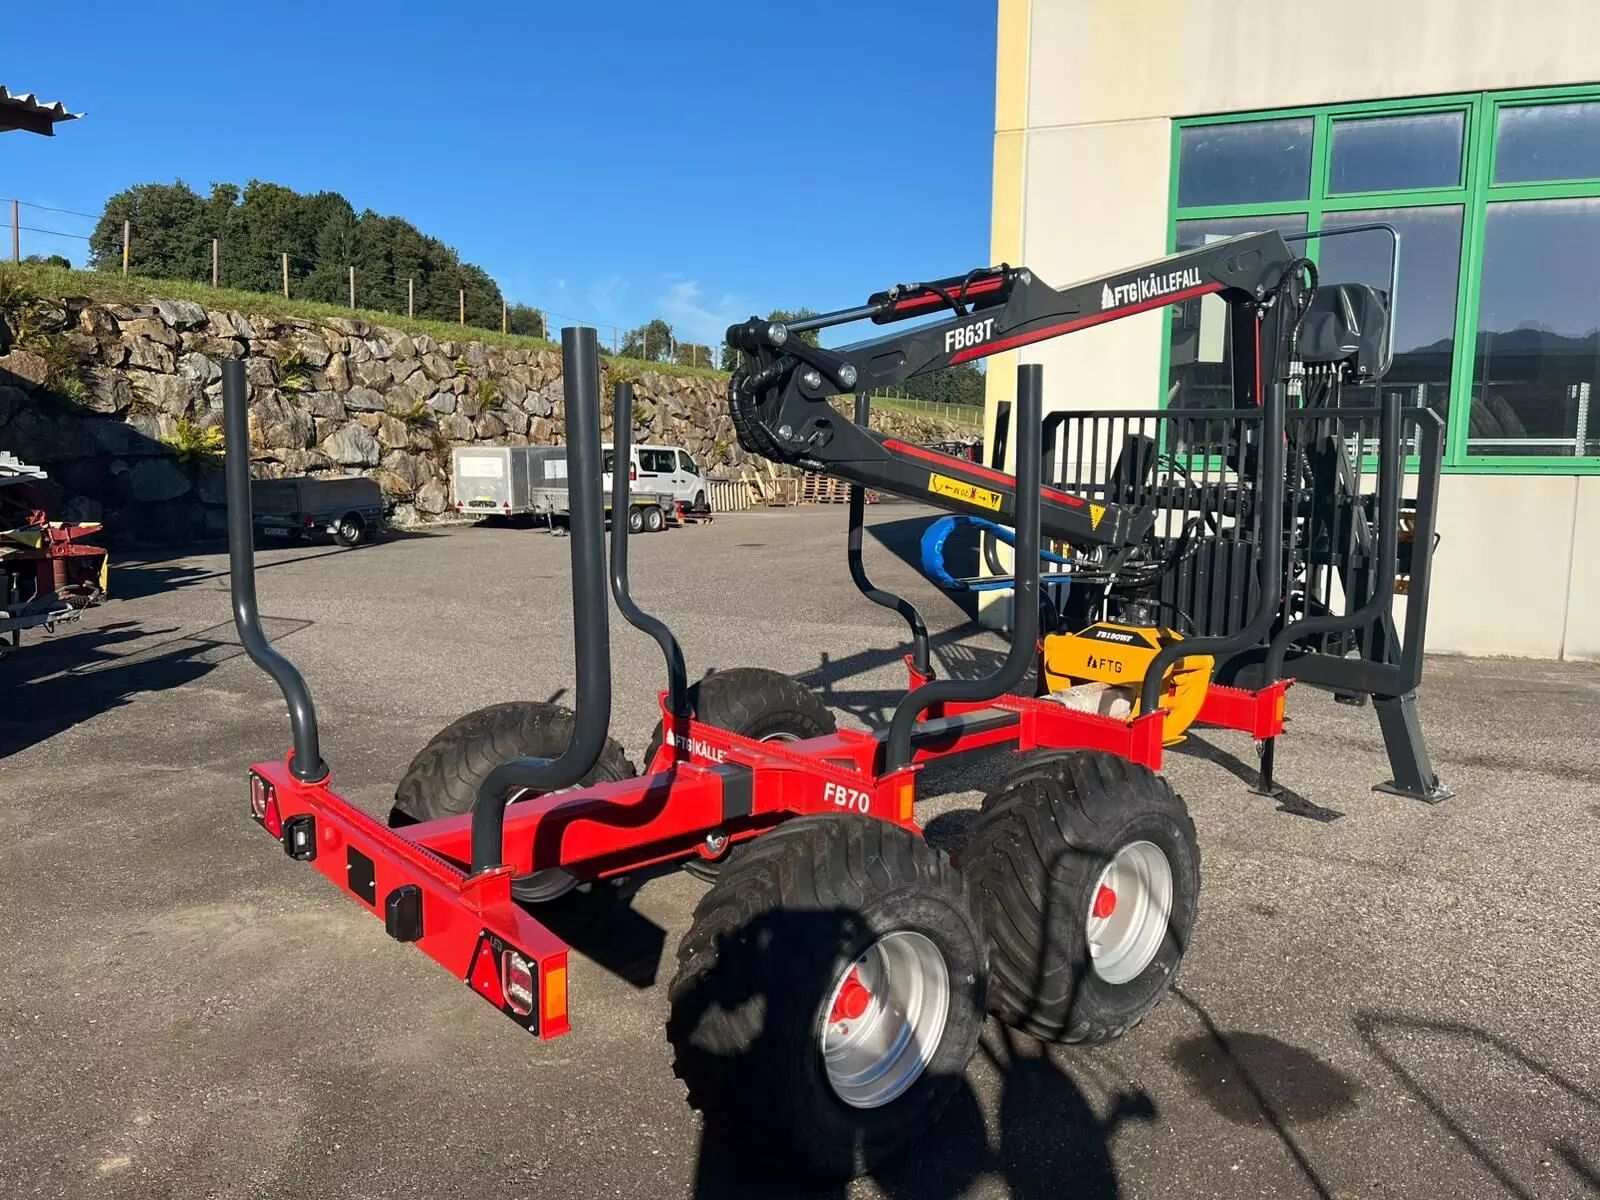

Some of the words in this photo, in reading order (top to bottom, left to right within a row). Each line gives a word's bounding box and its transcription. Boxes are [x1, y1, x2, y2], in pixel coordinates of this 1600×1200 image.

[945, 318, 994, 352] FB63T
[1099, 659, 1122, 673] FTG
[823, 782, 870, 814] FB70
